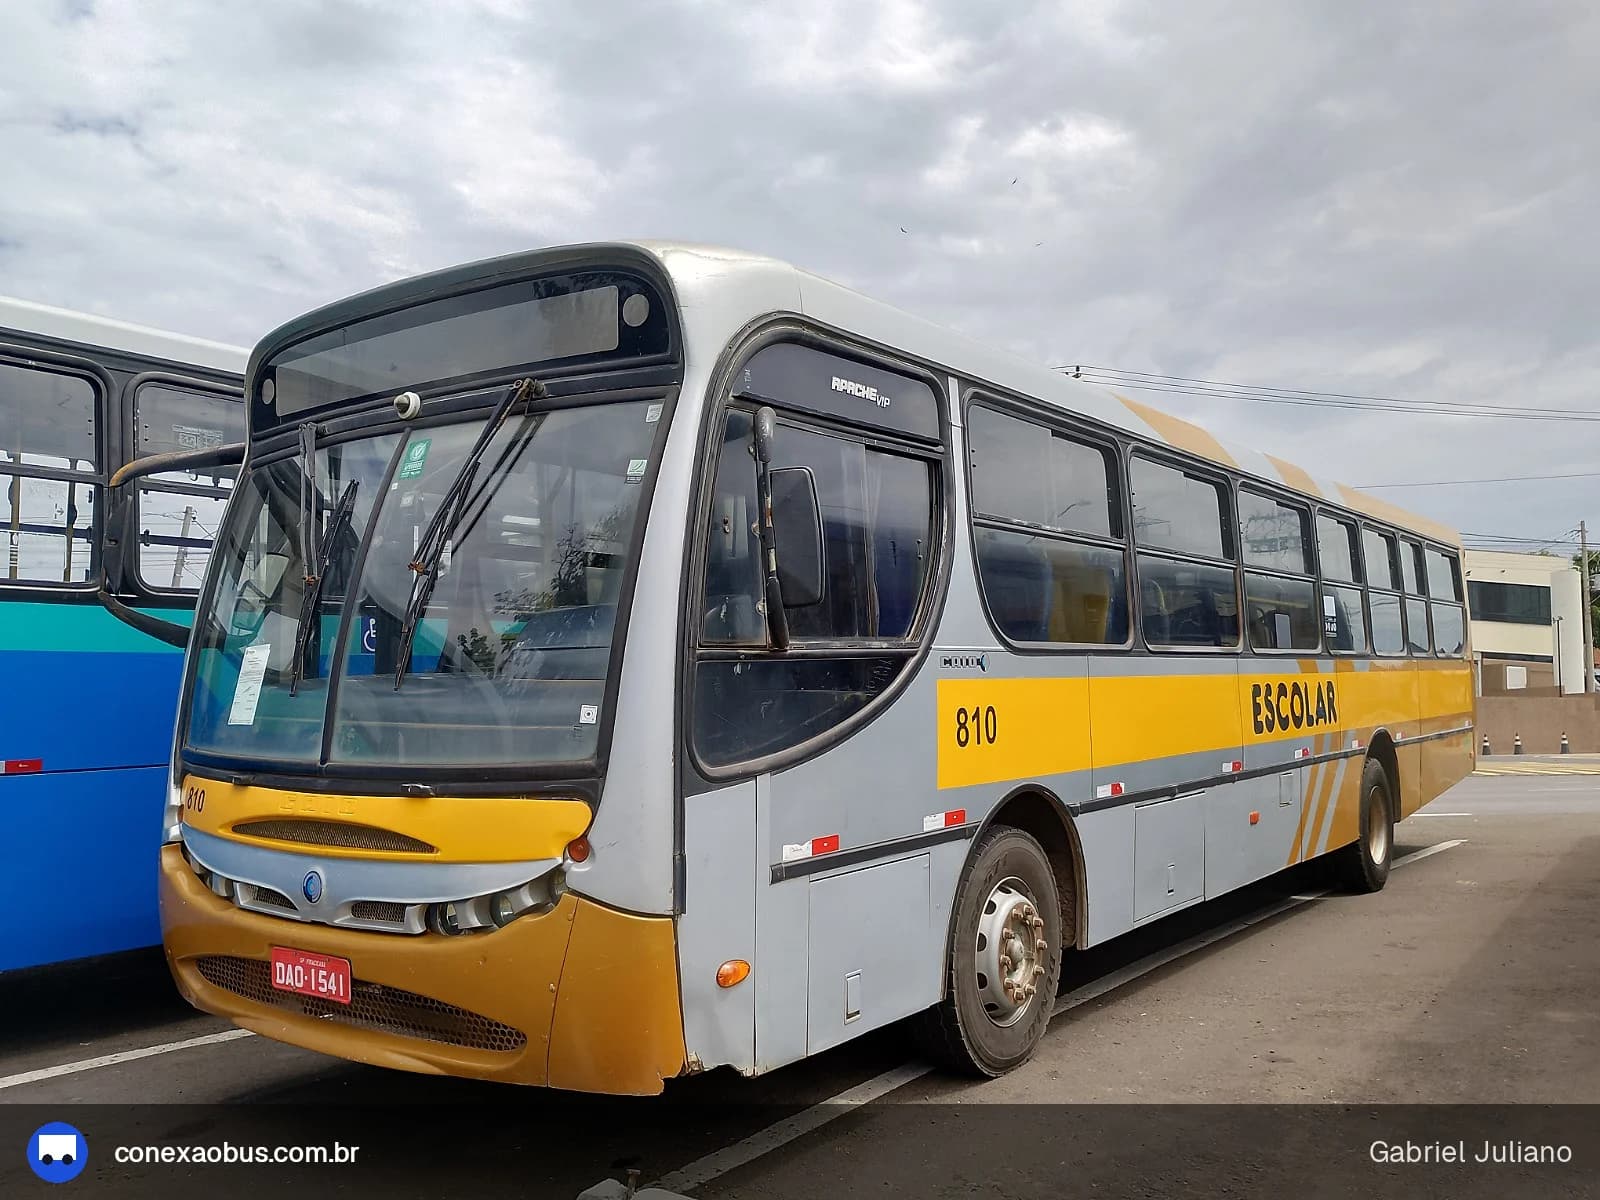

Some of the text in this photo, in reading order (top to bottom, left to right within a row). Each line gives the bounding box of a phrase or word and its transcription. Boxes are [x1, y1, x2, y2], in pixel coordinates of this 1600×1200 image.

[831, 376, 891, 408] APACHE VIP
[956, 705, 997, 748] 810
[1252, 681, 1338, 735] ESCOLAR
[186, 786, 205, 813] 810
